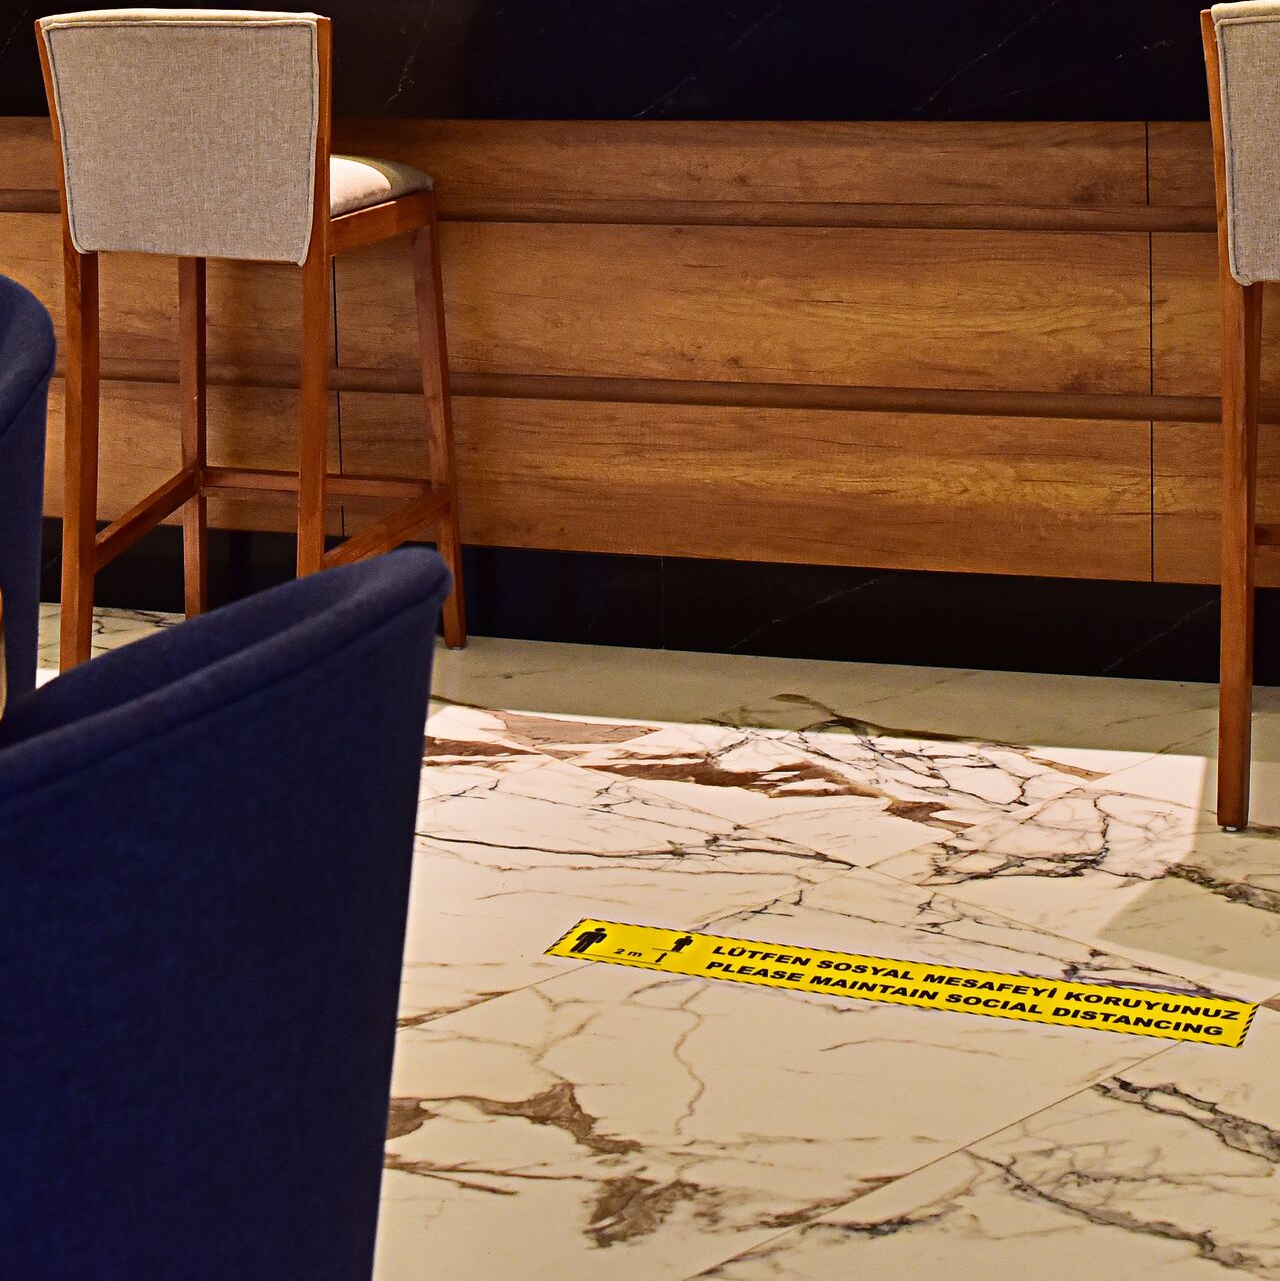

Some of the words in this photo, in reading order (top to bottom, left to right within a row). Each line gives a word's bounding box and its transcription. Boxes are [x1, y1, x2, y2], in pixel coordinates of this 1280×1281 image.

[613, 947, 625, 956] 2
[626, 950, 643, 958] m
[712, 945, 812, 967] LÜTFEN
[816, 958, 915, 981] SOSYAL
[923, 972, 1059, 999] MESAFEYİ
[1064, 990, 1241, 1021] KORUYUNUZ
[704, 961, 805, 983] PLEASE
[808, 975, 940, 1000] MAINTAIN
[944, 992, 1045, 1016] SOCIAL
[1049, 1006, 1225, 1037] DISTANCING
